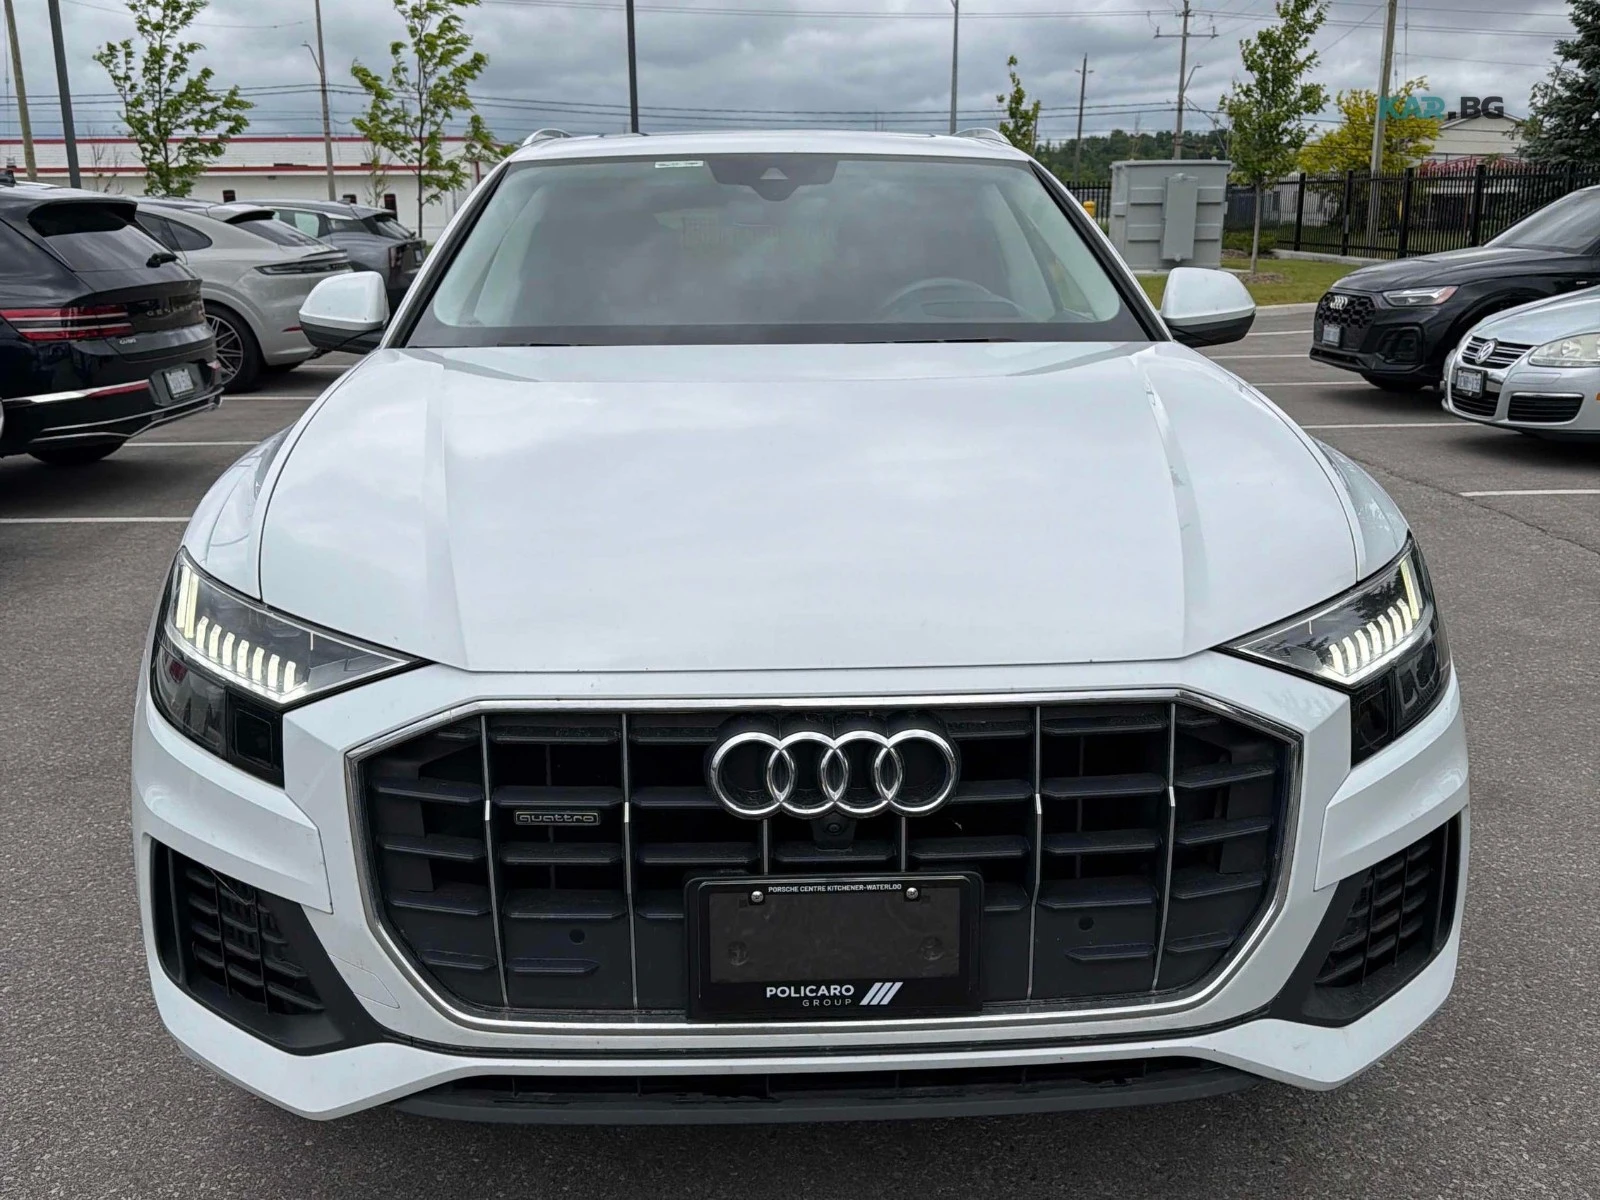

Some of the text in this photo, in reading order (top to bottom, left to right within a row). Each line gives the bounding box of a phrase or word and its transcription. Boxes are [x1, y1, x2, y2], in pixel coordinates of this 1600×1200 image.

[519, 814, 595, 823] quattro
[827, 883, 902, 891] KITCHENER-WATERLOO
[766, 984, 855, 998] POLICARO
[802, 998, 852, 1007] GROUP
